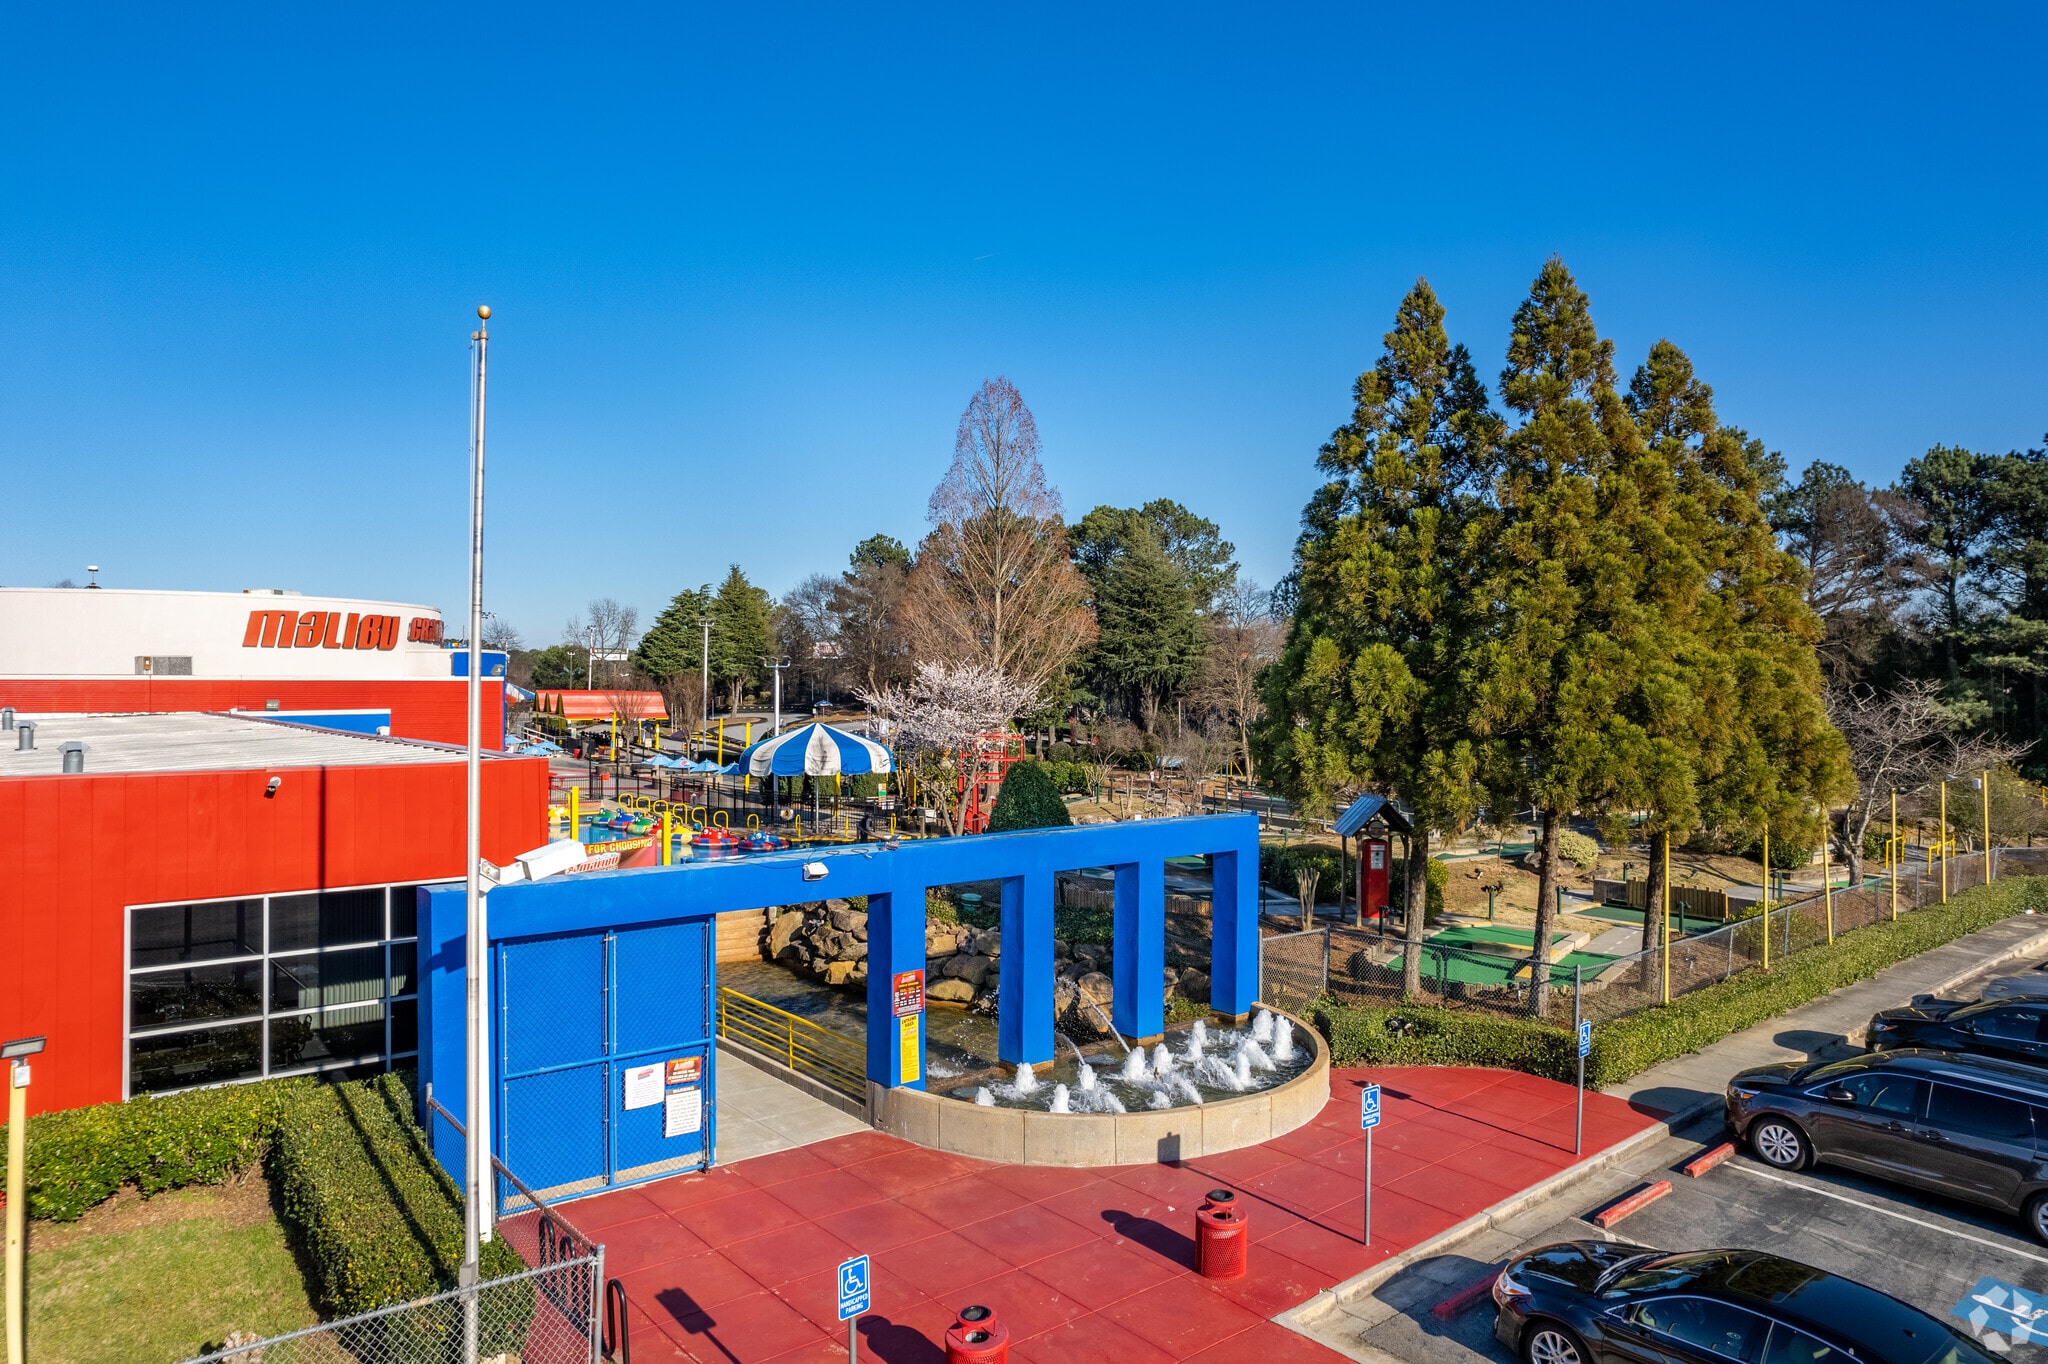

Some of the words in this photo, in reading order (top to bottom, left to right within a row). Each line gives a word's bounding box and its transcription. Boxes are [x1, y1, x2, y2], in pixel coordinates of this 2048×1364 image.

[588, 843, 607, 854] FOR
[609, 838, 653, 852] CHOOSING
[840, 1293, 868, 1309] HANDICAPPED
[846, 1301, 863, 1314] PARKING
